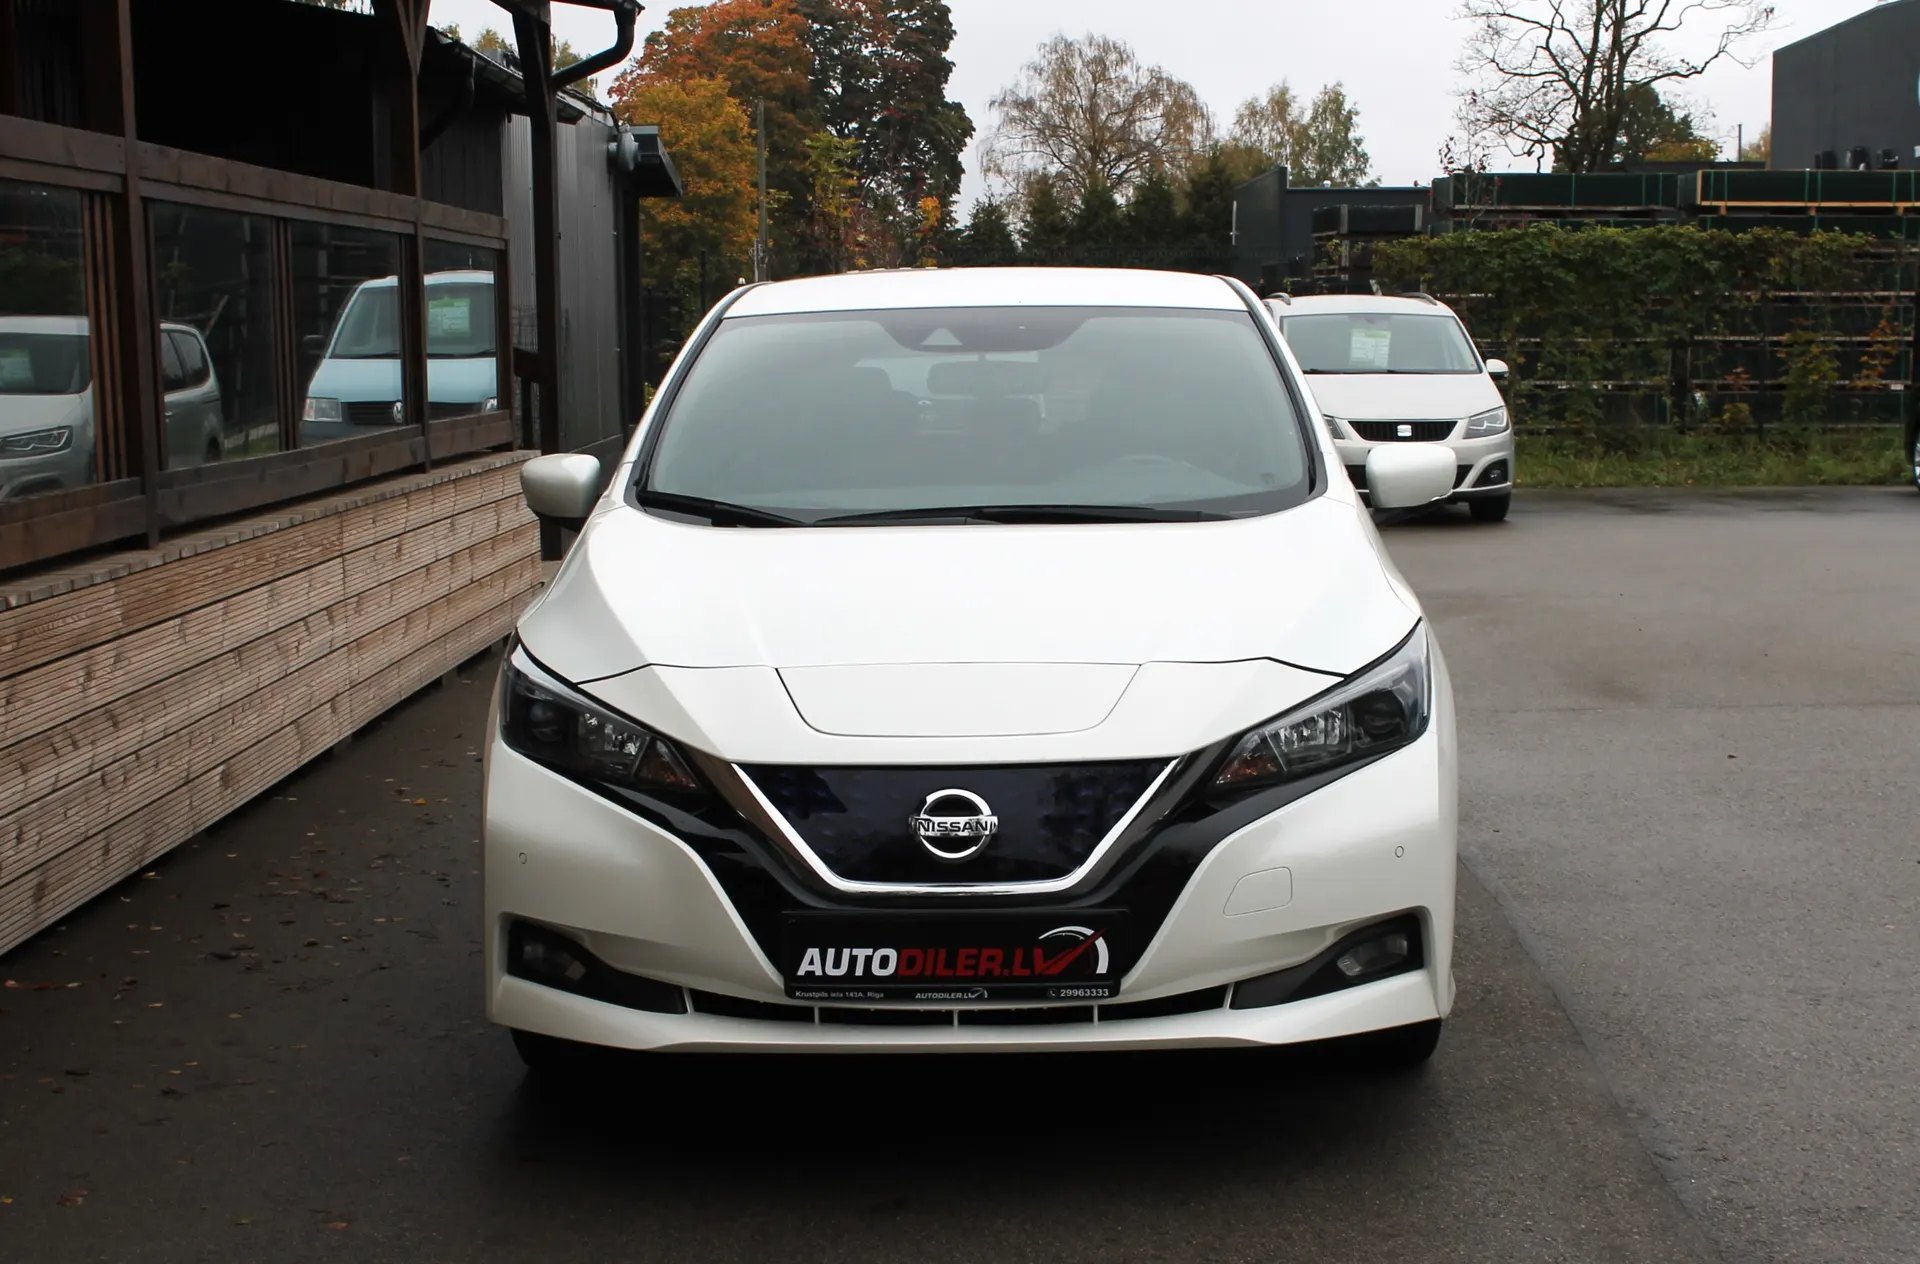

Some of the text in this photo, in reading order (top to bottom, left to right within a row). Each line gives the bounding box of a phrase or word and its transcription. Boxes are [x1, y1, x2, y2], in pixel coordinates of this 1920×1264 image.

[917, 820, 988, 833] NISSAN
[796, 940, 1084, 977] AUTODILER.LV
[1060, 988, 1109, 997] 29963333
